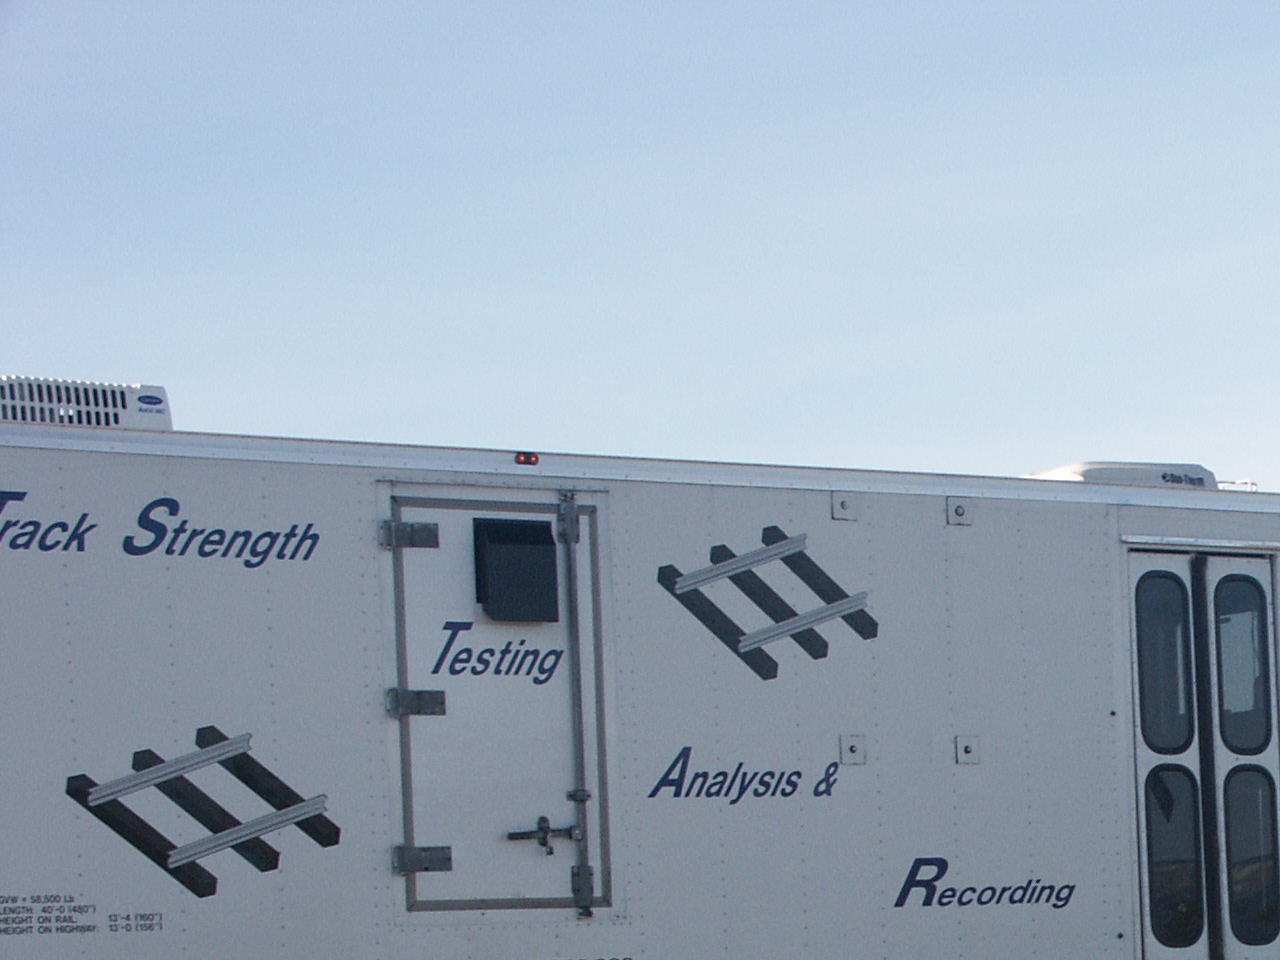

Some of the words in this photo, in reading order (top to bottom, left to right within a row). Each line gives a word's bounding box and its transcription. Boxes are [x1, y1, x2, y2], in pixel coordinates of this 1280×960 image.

[122, 497, 320, 568] Strength
[431, 621, 564, 685] Testing
[648, 746, 802, 805] Analysis
[813, 761, 839, 797] &
[894, 857, 1076, 909] Recording
[38, 915, 52, 924] ON
[38, 925, 52, 934] ON
